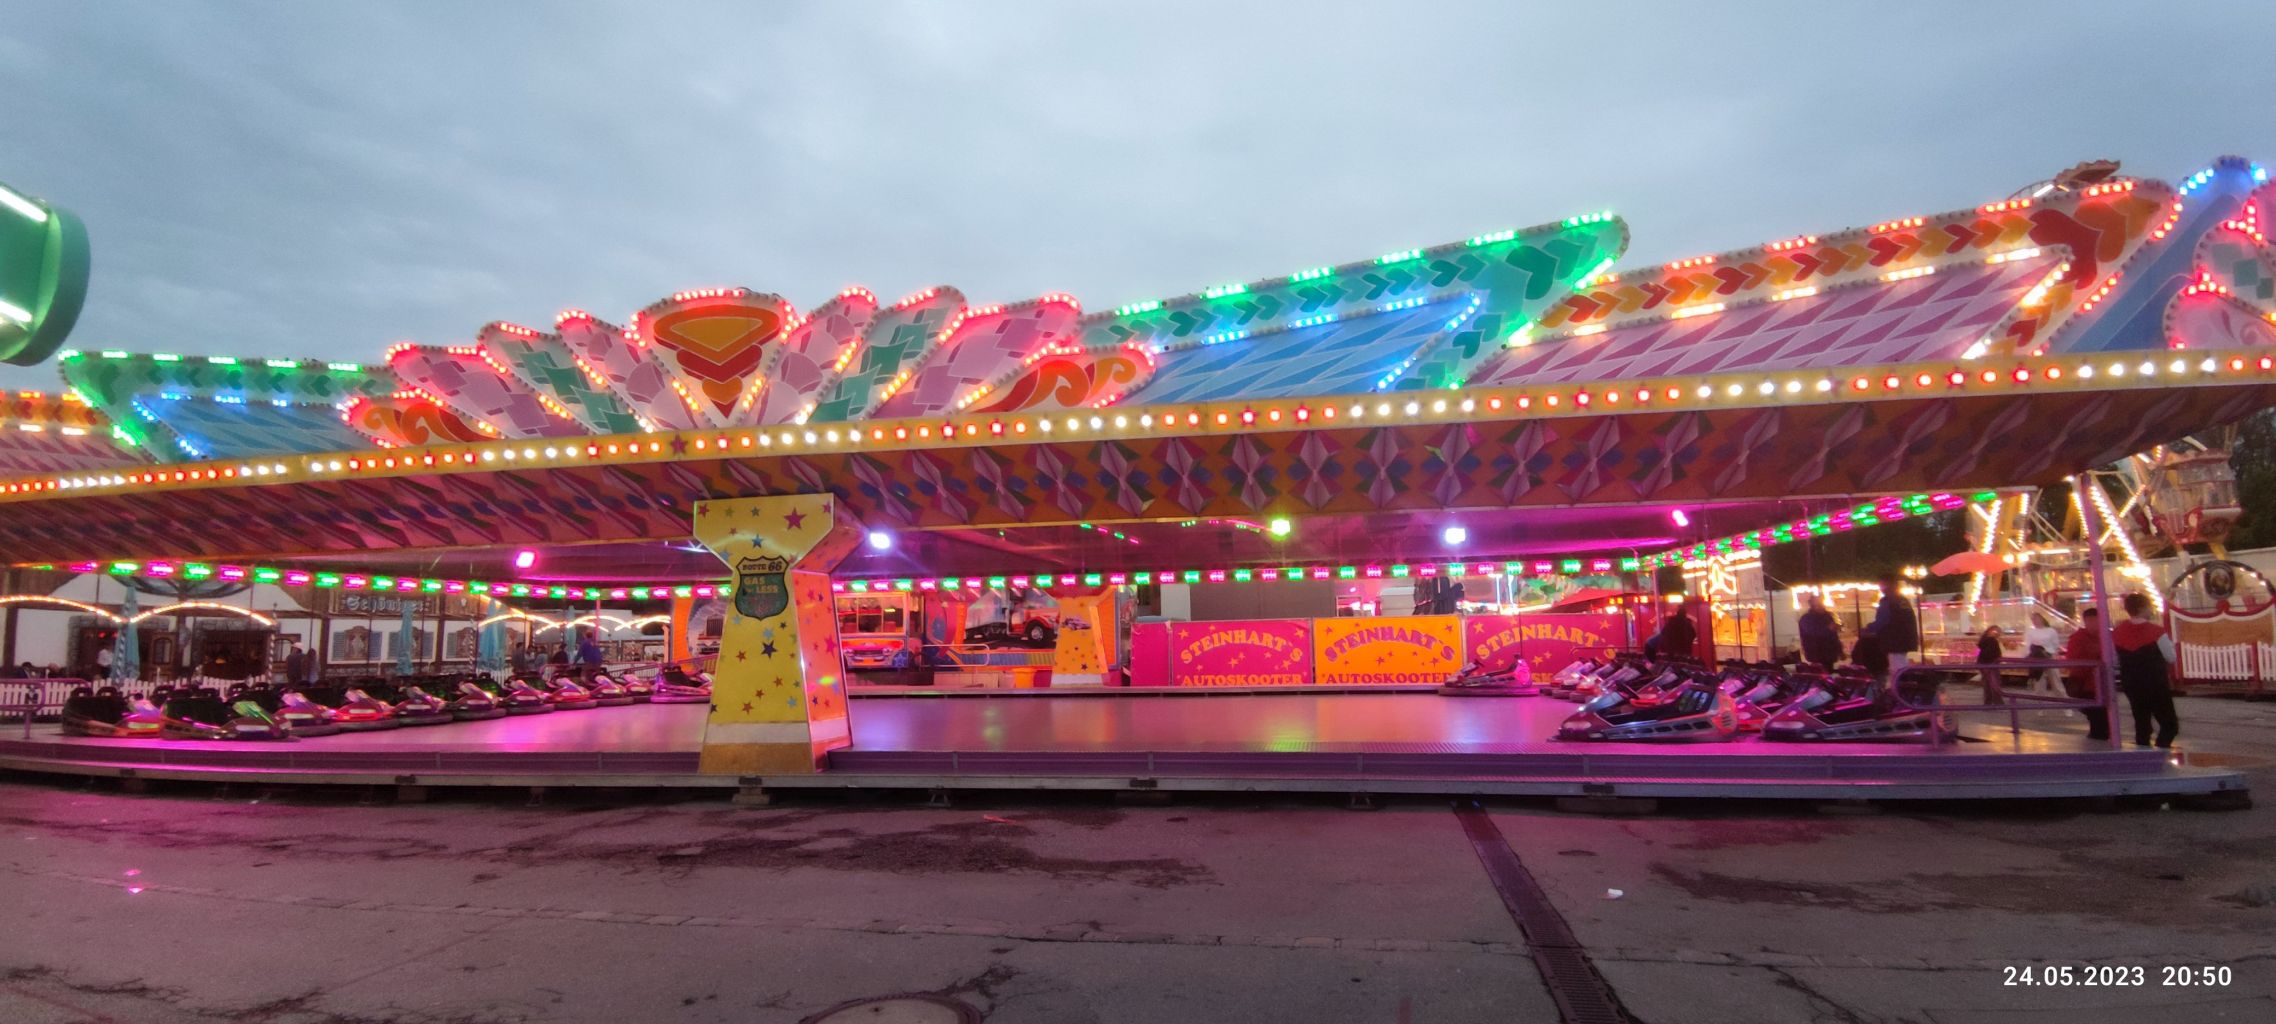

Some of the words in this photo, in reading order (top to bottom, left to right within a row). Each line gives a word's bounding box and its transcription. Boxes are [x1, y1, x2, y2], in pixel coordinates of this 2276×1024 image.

[768, 561, 782, 572] 66
[743, 577, 765, 585] GAS
[755, 585, 778, 593] LESS
[1181, 674, 1302, 687] AUTOSKOOTER
